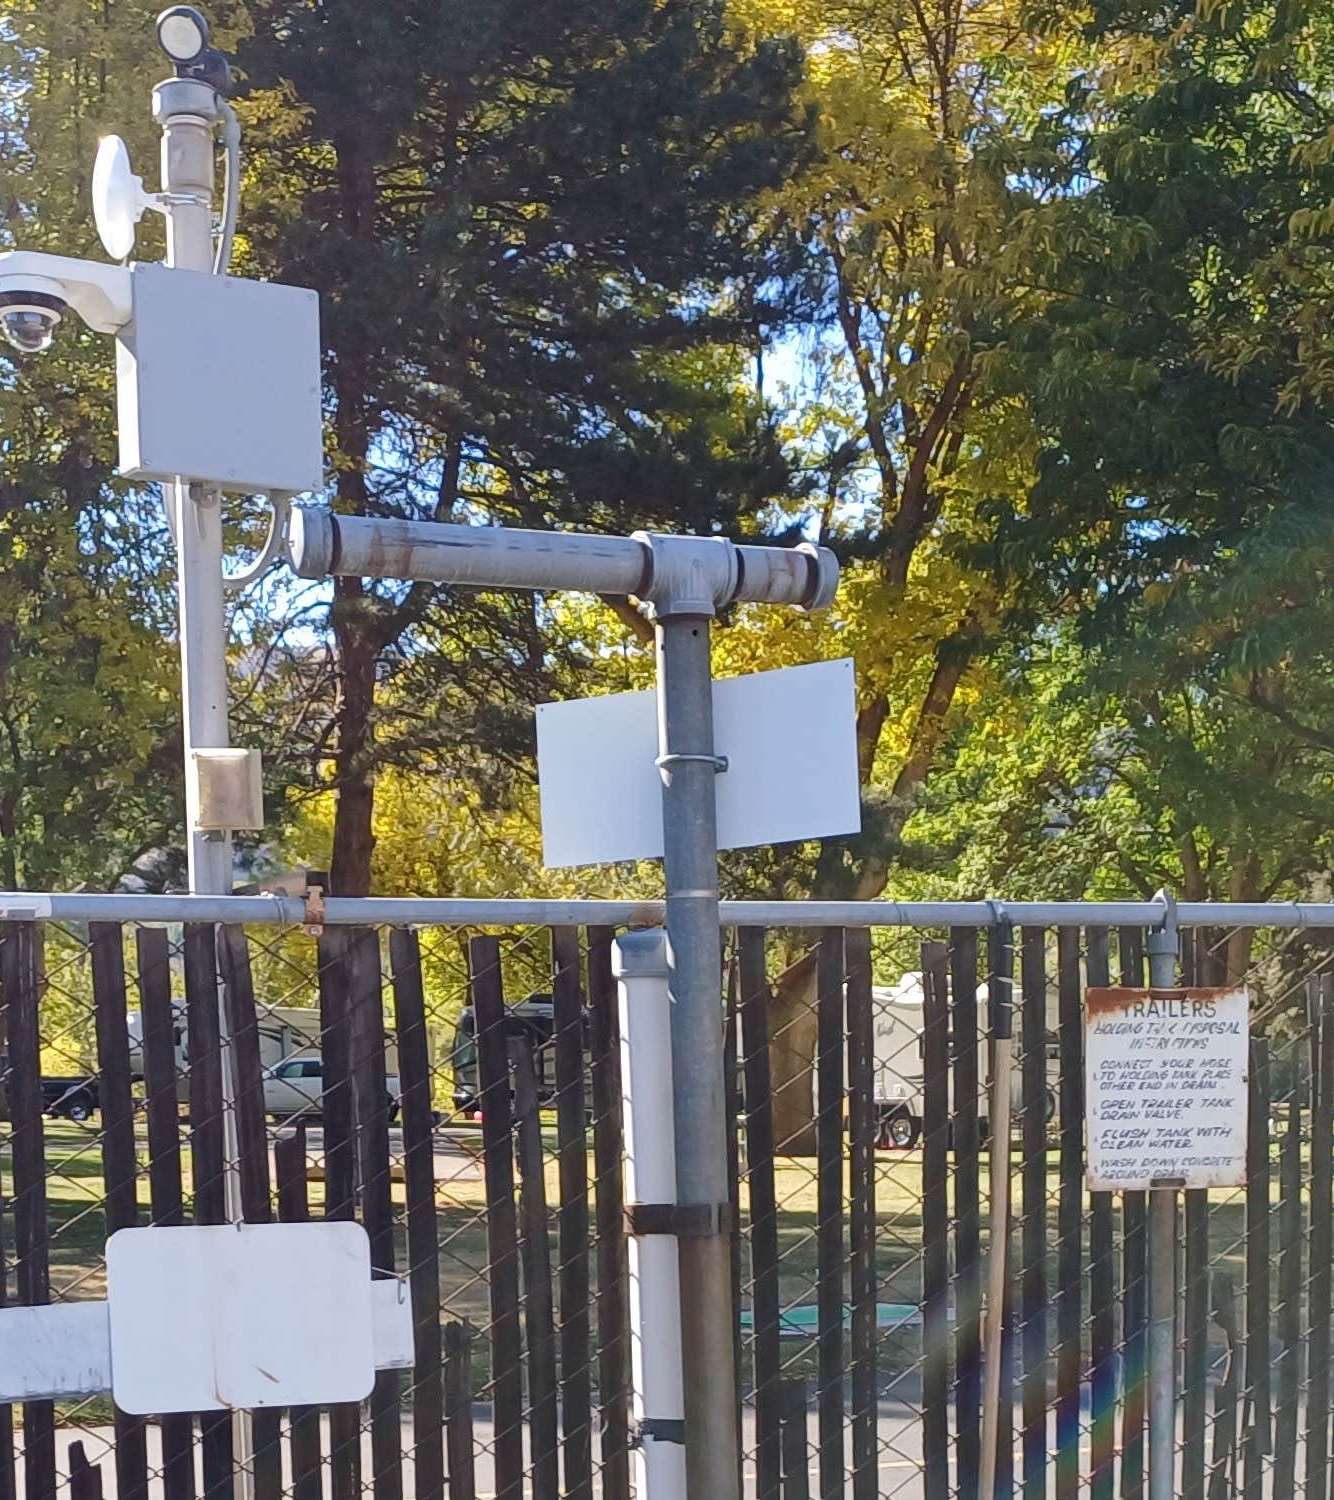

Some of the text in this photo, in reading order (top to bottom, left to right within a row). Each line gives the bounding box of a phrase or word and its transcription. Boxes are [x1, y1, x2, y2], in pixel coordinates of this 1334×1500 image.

[1159, 1058, 1195, 1068] YOUR
[1099, 1071, 1115, 1081] TO
[1099, 1081, 1136, 1091] OTHER
[1138, 1080, 1163, 1090] END
[1164, 1081, 1178, 1090] IN
[1100, 1097, 1236, 1110] OPEN TRAILER TANK
[1099, 1110, 1141, 1120] DRAIN
[1100, 1128, 1151, 1140] FLUSH
[1155, 1127, 1195, 1138] TANK
[1196, 1126, 1233, 1137] WITH
[1099, 1139, 1145, 1150] CLEAN
